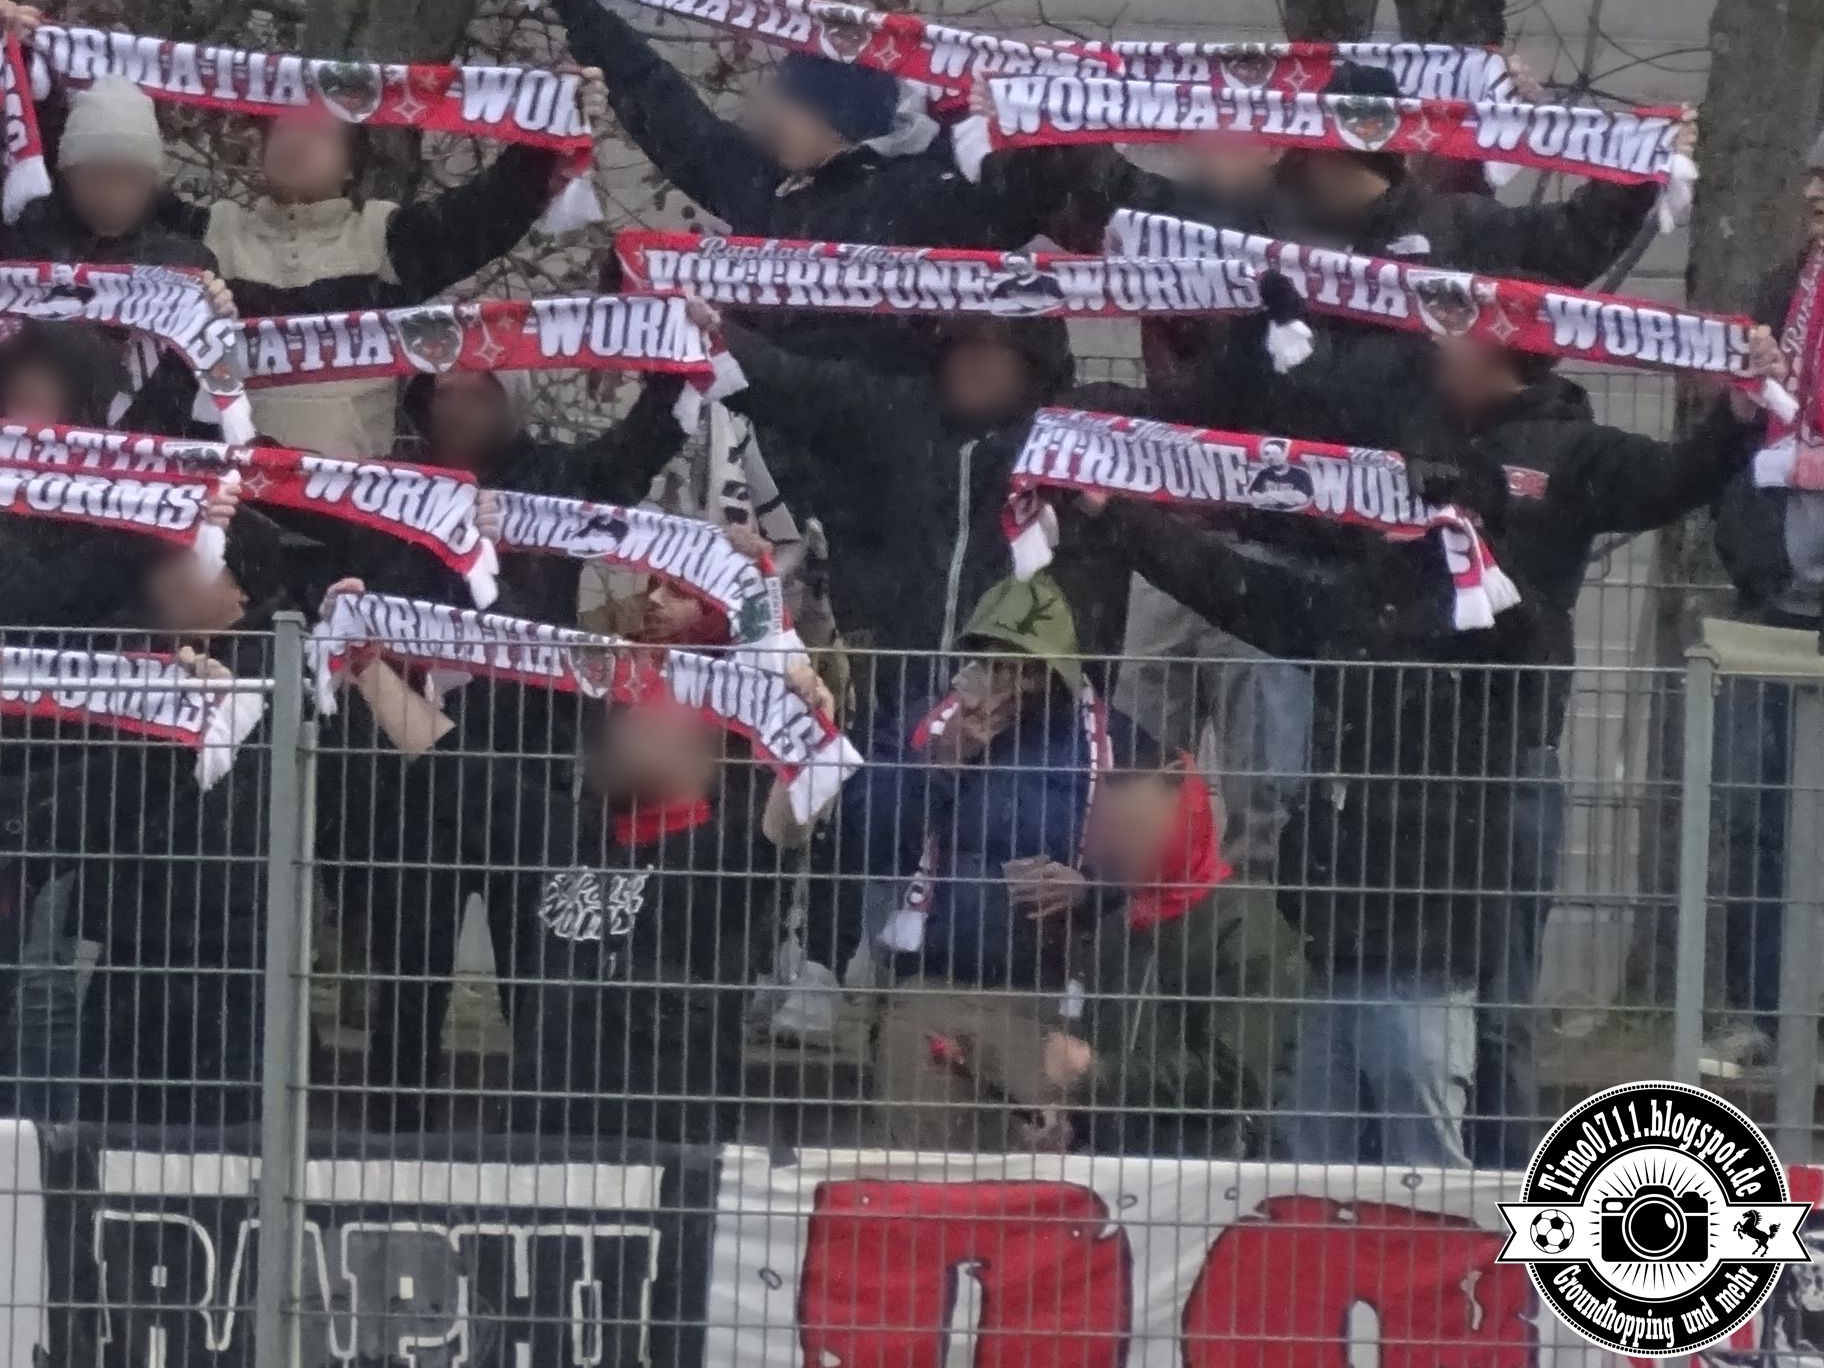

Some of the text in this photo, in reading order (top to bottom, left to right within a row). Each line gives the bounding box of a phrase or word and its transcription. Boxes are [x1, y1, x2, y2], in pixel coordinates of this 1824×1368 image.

[989, 75, 1327, 138] WORMATIA
[1050, 260, 1265, 311] WORMS
[529, 294, 708, 364] WORM
